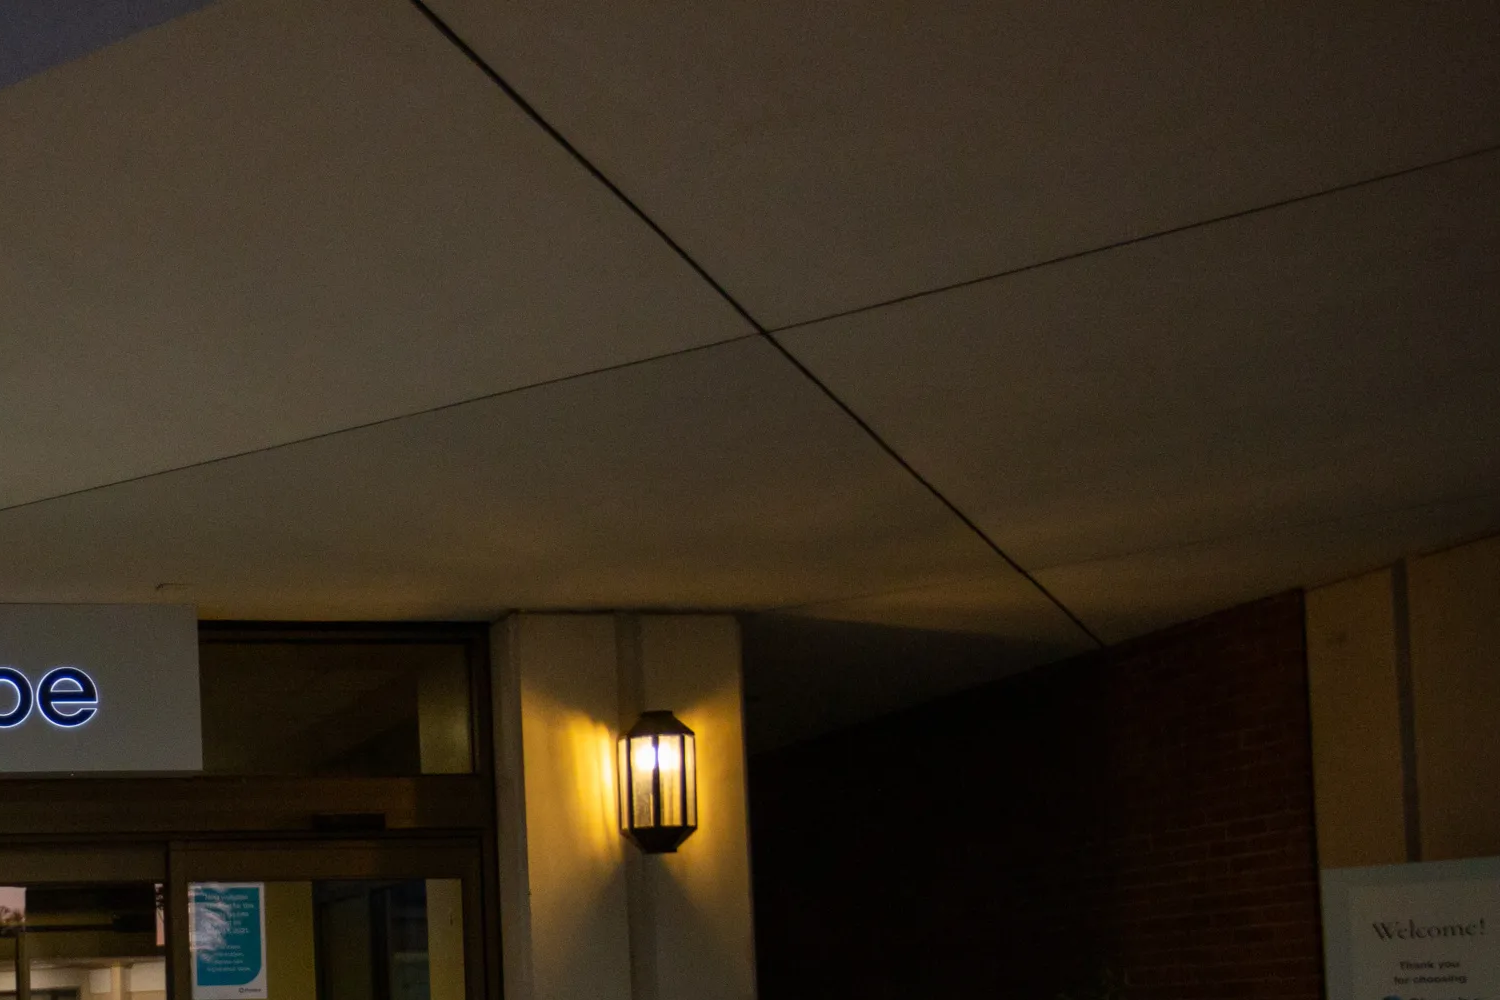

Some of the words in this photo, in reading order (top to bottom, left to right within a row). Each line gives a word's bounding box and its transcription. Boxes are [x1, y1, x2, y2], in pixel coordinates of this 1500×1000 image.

[1372, 918, 1486, 941] Welcome!
[1400, 961, 1433, 970] Thank
[1438, 961, 1460, 970] you
[1394, 976, 1409, 984] for
[1412, 975, 1468, 984] choosing
